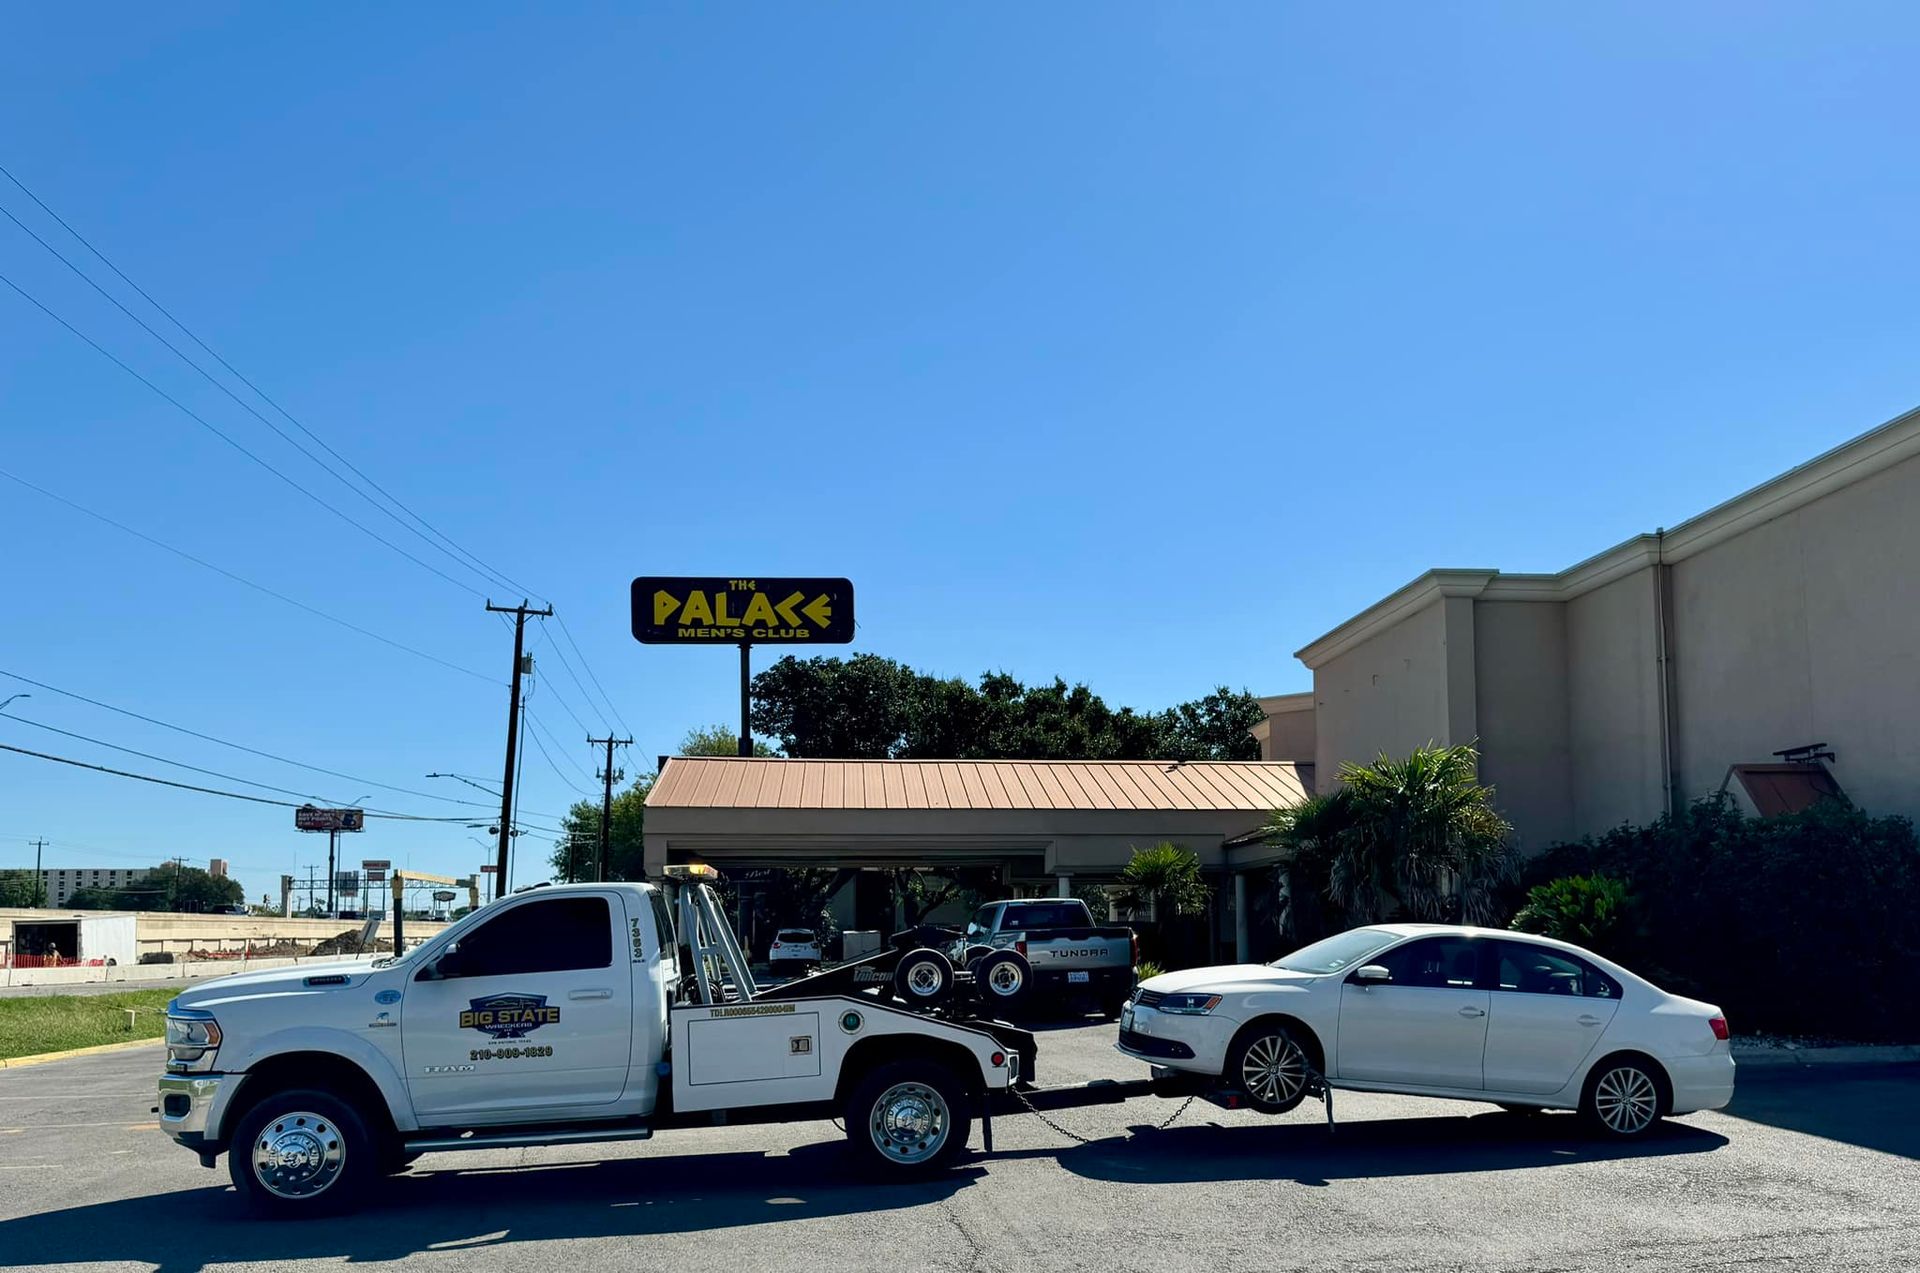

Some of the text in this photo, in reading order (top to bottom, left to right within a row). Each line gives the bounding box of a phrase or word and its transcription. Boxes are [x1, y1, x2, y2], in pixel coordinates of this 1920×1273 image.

[729, 580, 756, 591] THE
[653, 590, 832, 629] PALACE
[677, 628, 811, 638] MEN'S CLUB
[1050, 948, 1109, 958] TUNDRA
[461, 1008, 559, 1027] BIG STATE
[424, 1064, 475, 1073] RAM
